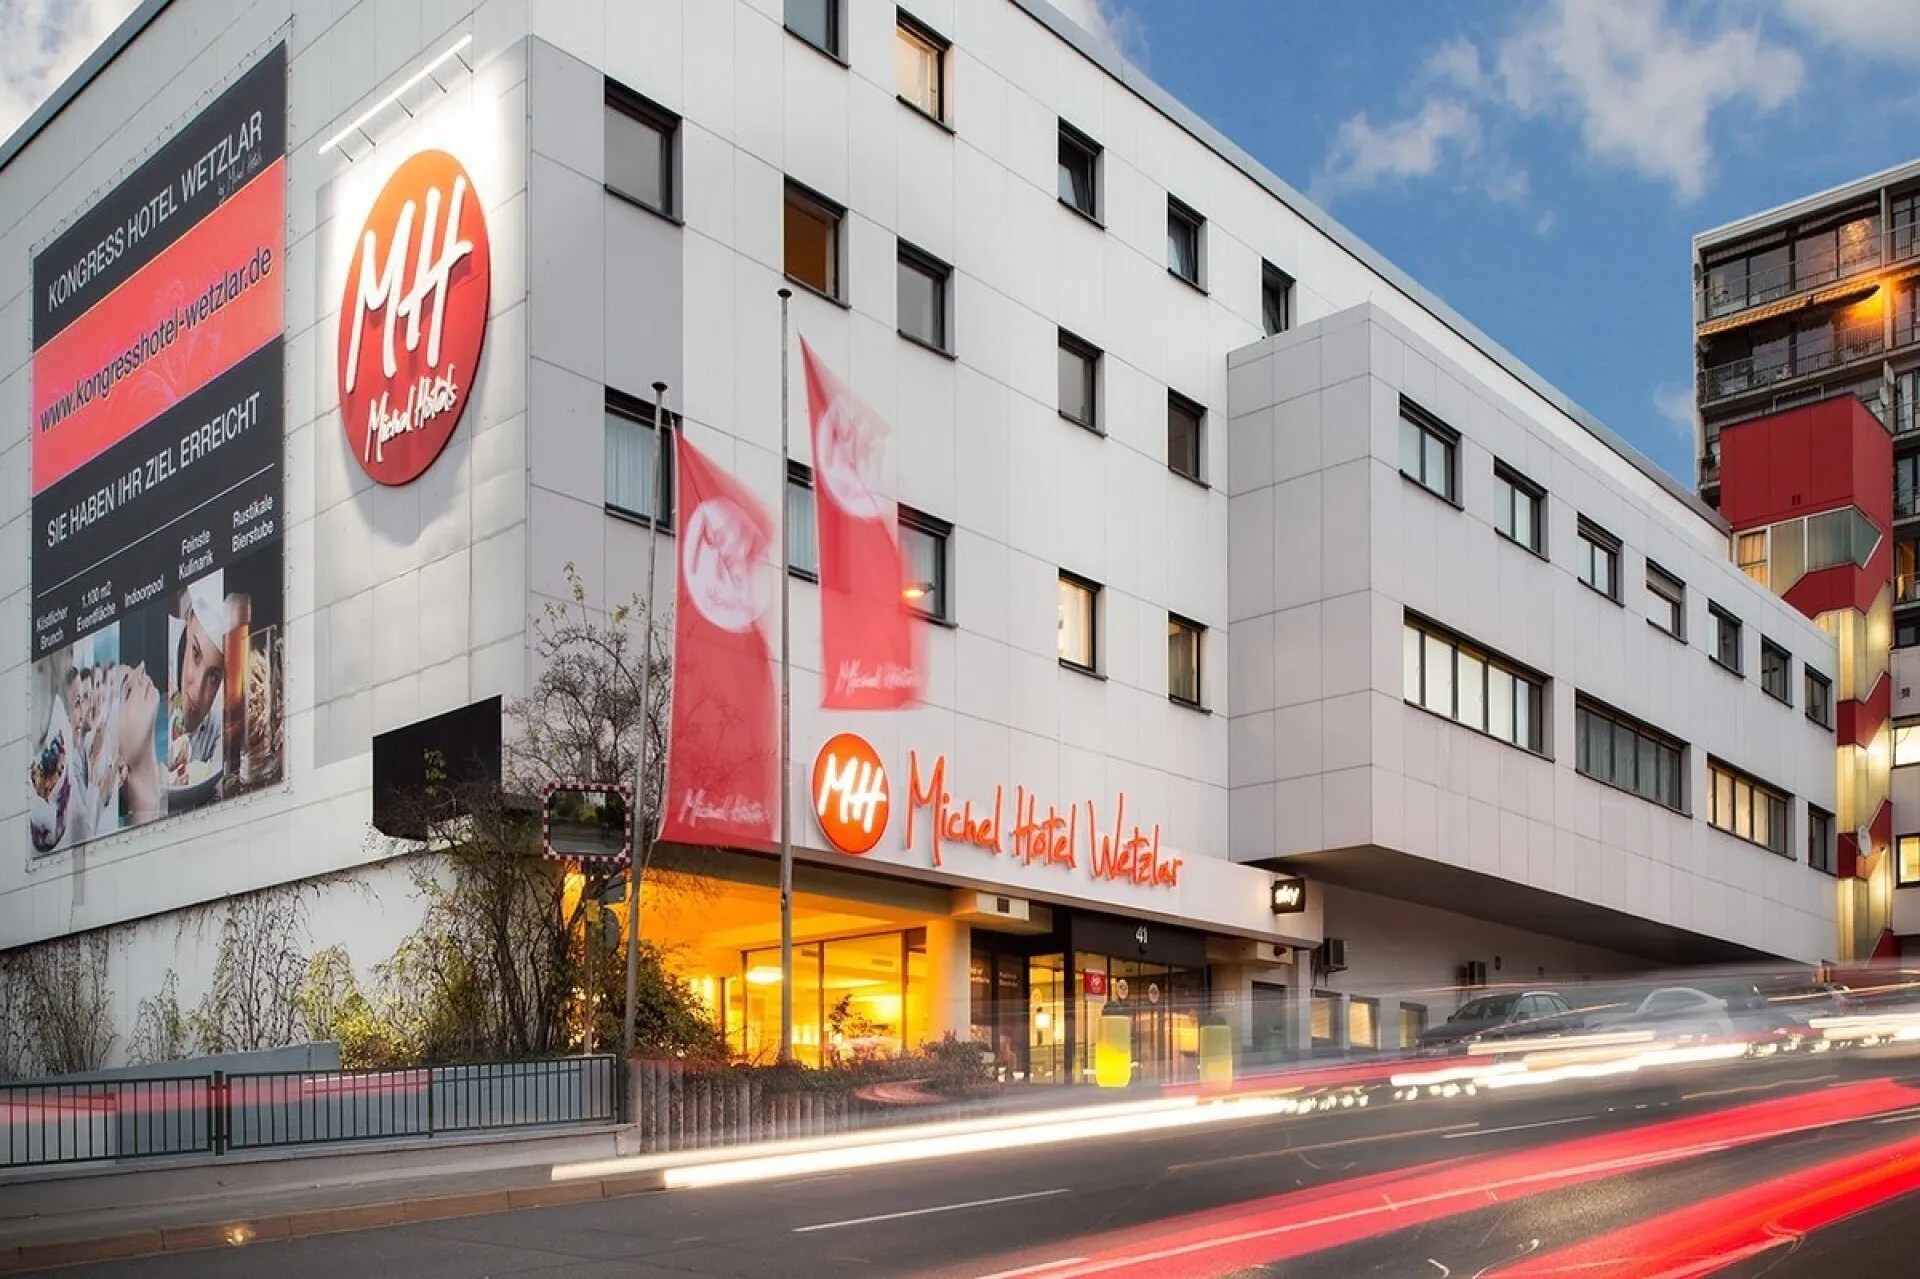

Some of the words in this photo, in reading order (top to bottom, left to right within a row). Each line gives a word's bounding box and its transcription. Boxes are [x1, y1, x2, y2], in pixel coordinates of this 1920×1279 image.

[48, 226, 124, 313] KONGRESS
[127, 184, 178, 249] HOTEL
[181, 110, 262, 202] WETZLAR
[345, 174, 473, 394] MH
[40, 246, 272, 433] www.kongresshotel-wetzlar.de
[47, 512, 67, 548] SIE
[69, 483, 115, 535] HABEN
[118, 467, 142, 507] IHR
[145, 447, 177, 490] ZIEL
[180, 391, 261, 470] ERREICHT
[233, 493, 273, 530] Rustikale
[181, 529, 211, 556] Feinste
[231, 520, 274, 553] Bierstube
[178, 549, 214, 581] Kulinarik
[124, 573, 164, 609] Indoorpool
[40, 626, 65, 651] Brunch
[818, 752, 887, 834] MH
[904, 749, 1003, 868] Michel
[1009, 784, 1077, 870] Hotel
[1087, 792, 1184, 887] Wetzlar
[1274, 884, 1300, 906] sky
[1135, 926, 1148, 944] 41
